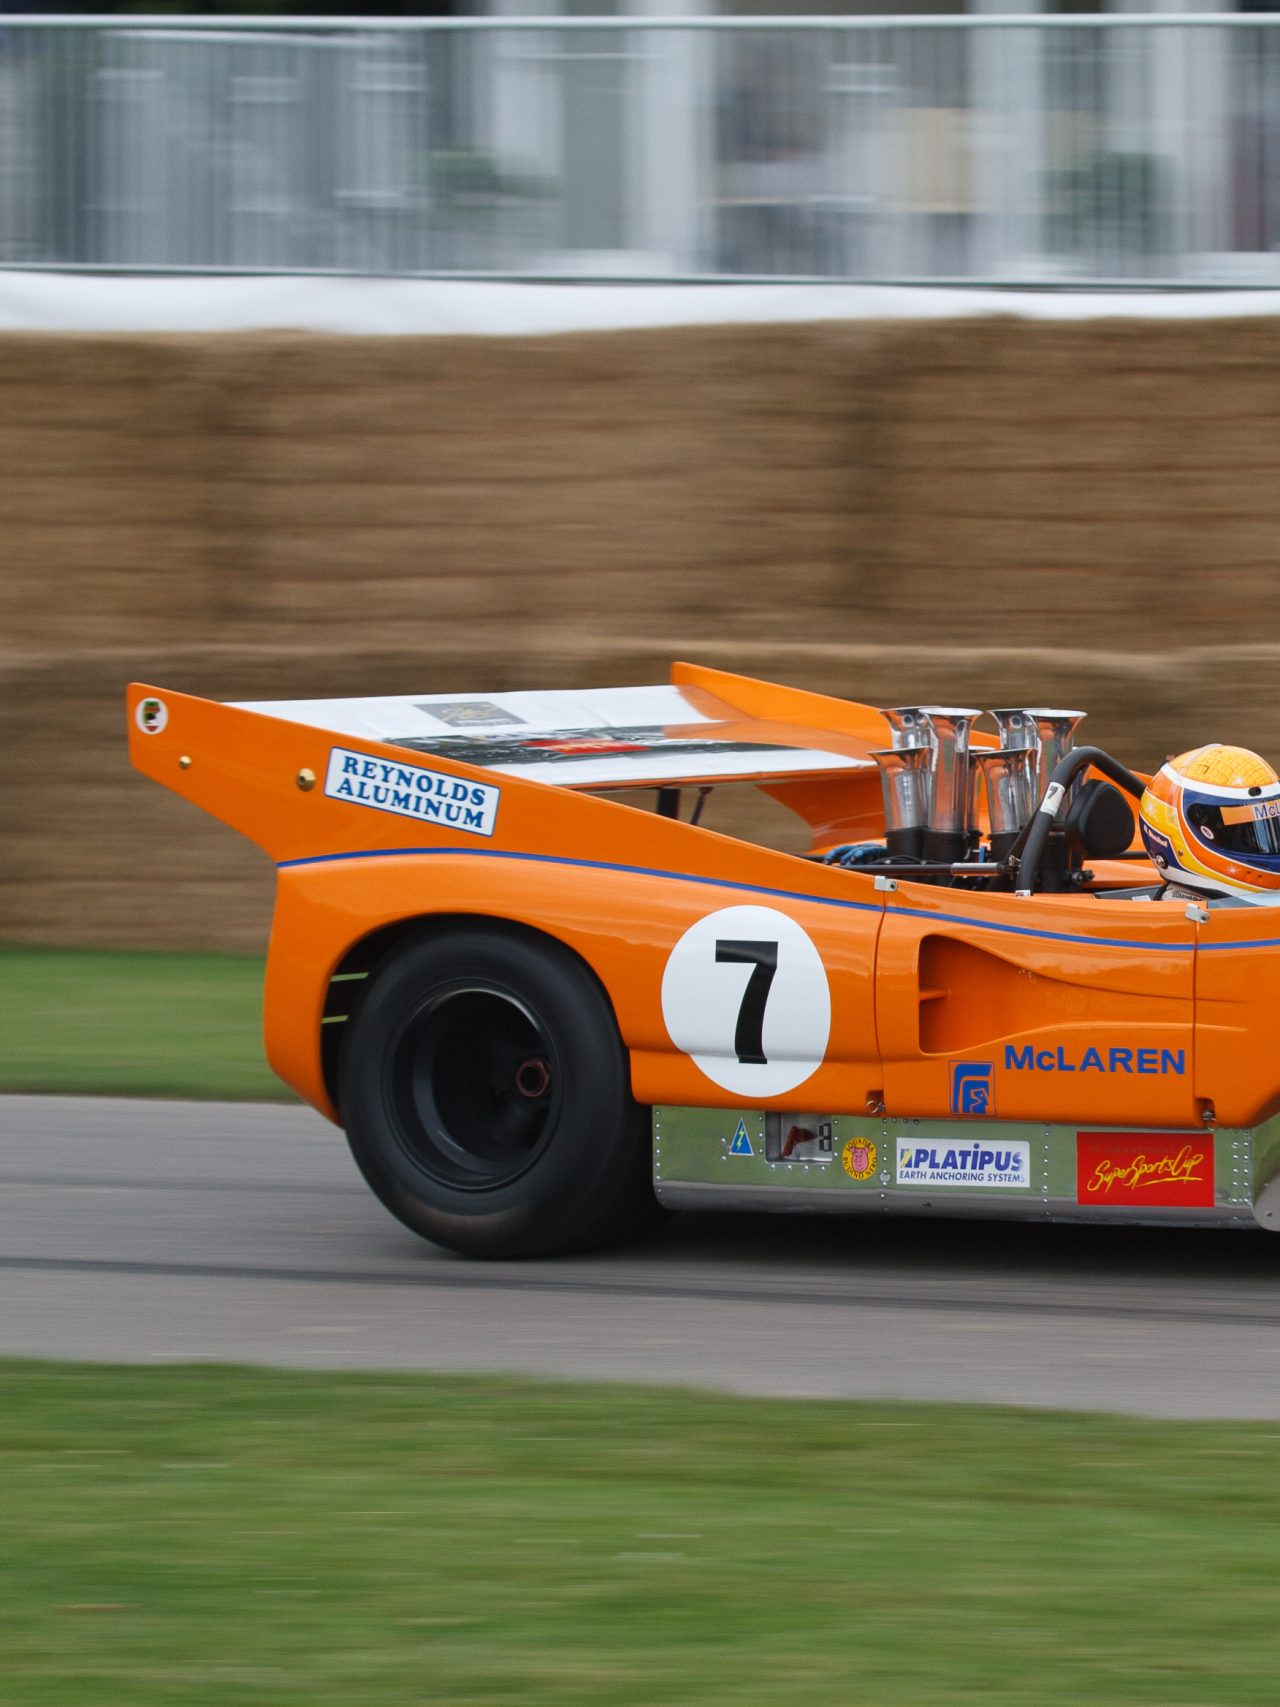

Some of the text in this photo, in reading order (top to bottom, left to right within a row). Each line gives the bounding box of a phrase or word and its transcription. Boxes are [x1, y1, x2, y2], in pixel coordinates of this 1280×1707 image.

[336, 777, 485, 829] ALUMINUM
[342, 755, 486, 807] REYNOLDS
[715, 939, 779, 1065] 7
[1004, 1045, 1185, 1075] McLAREN
[900, 1170, 1025, 1183] EARTH ANCHORING SYSTEMS
